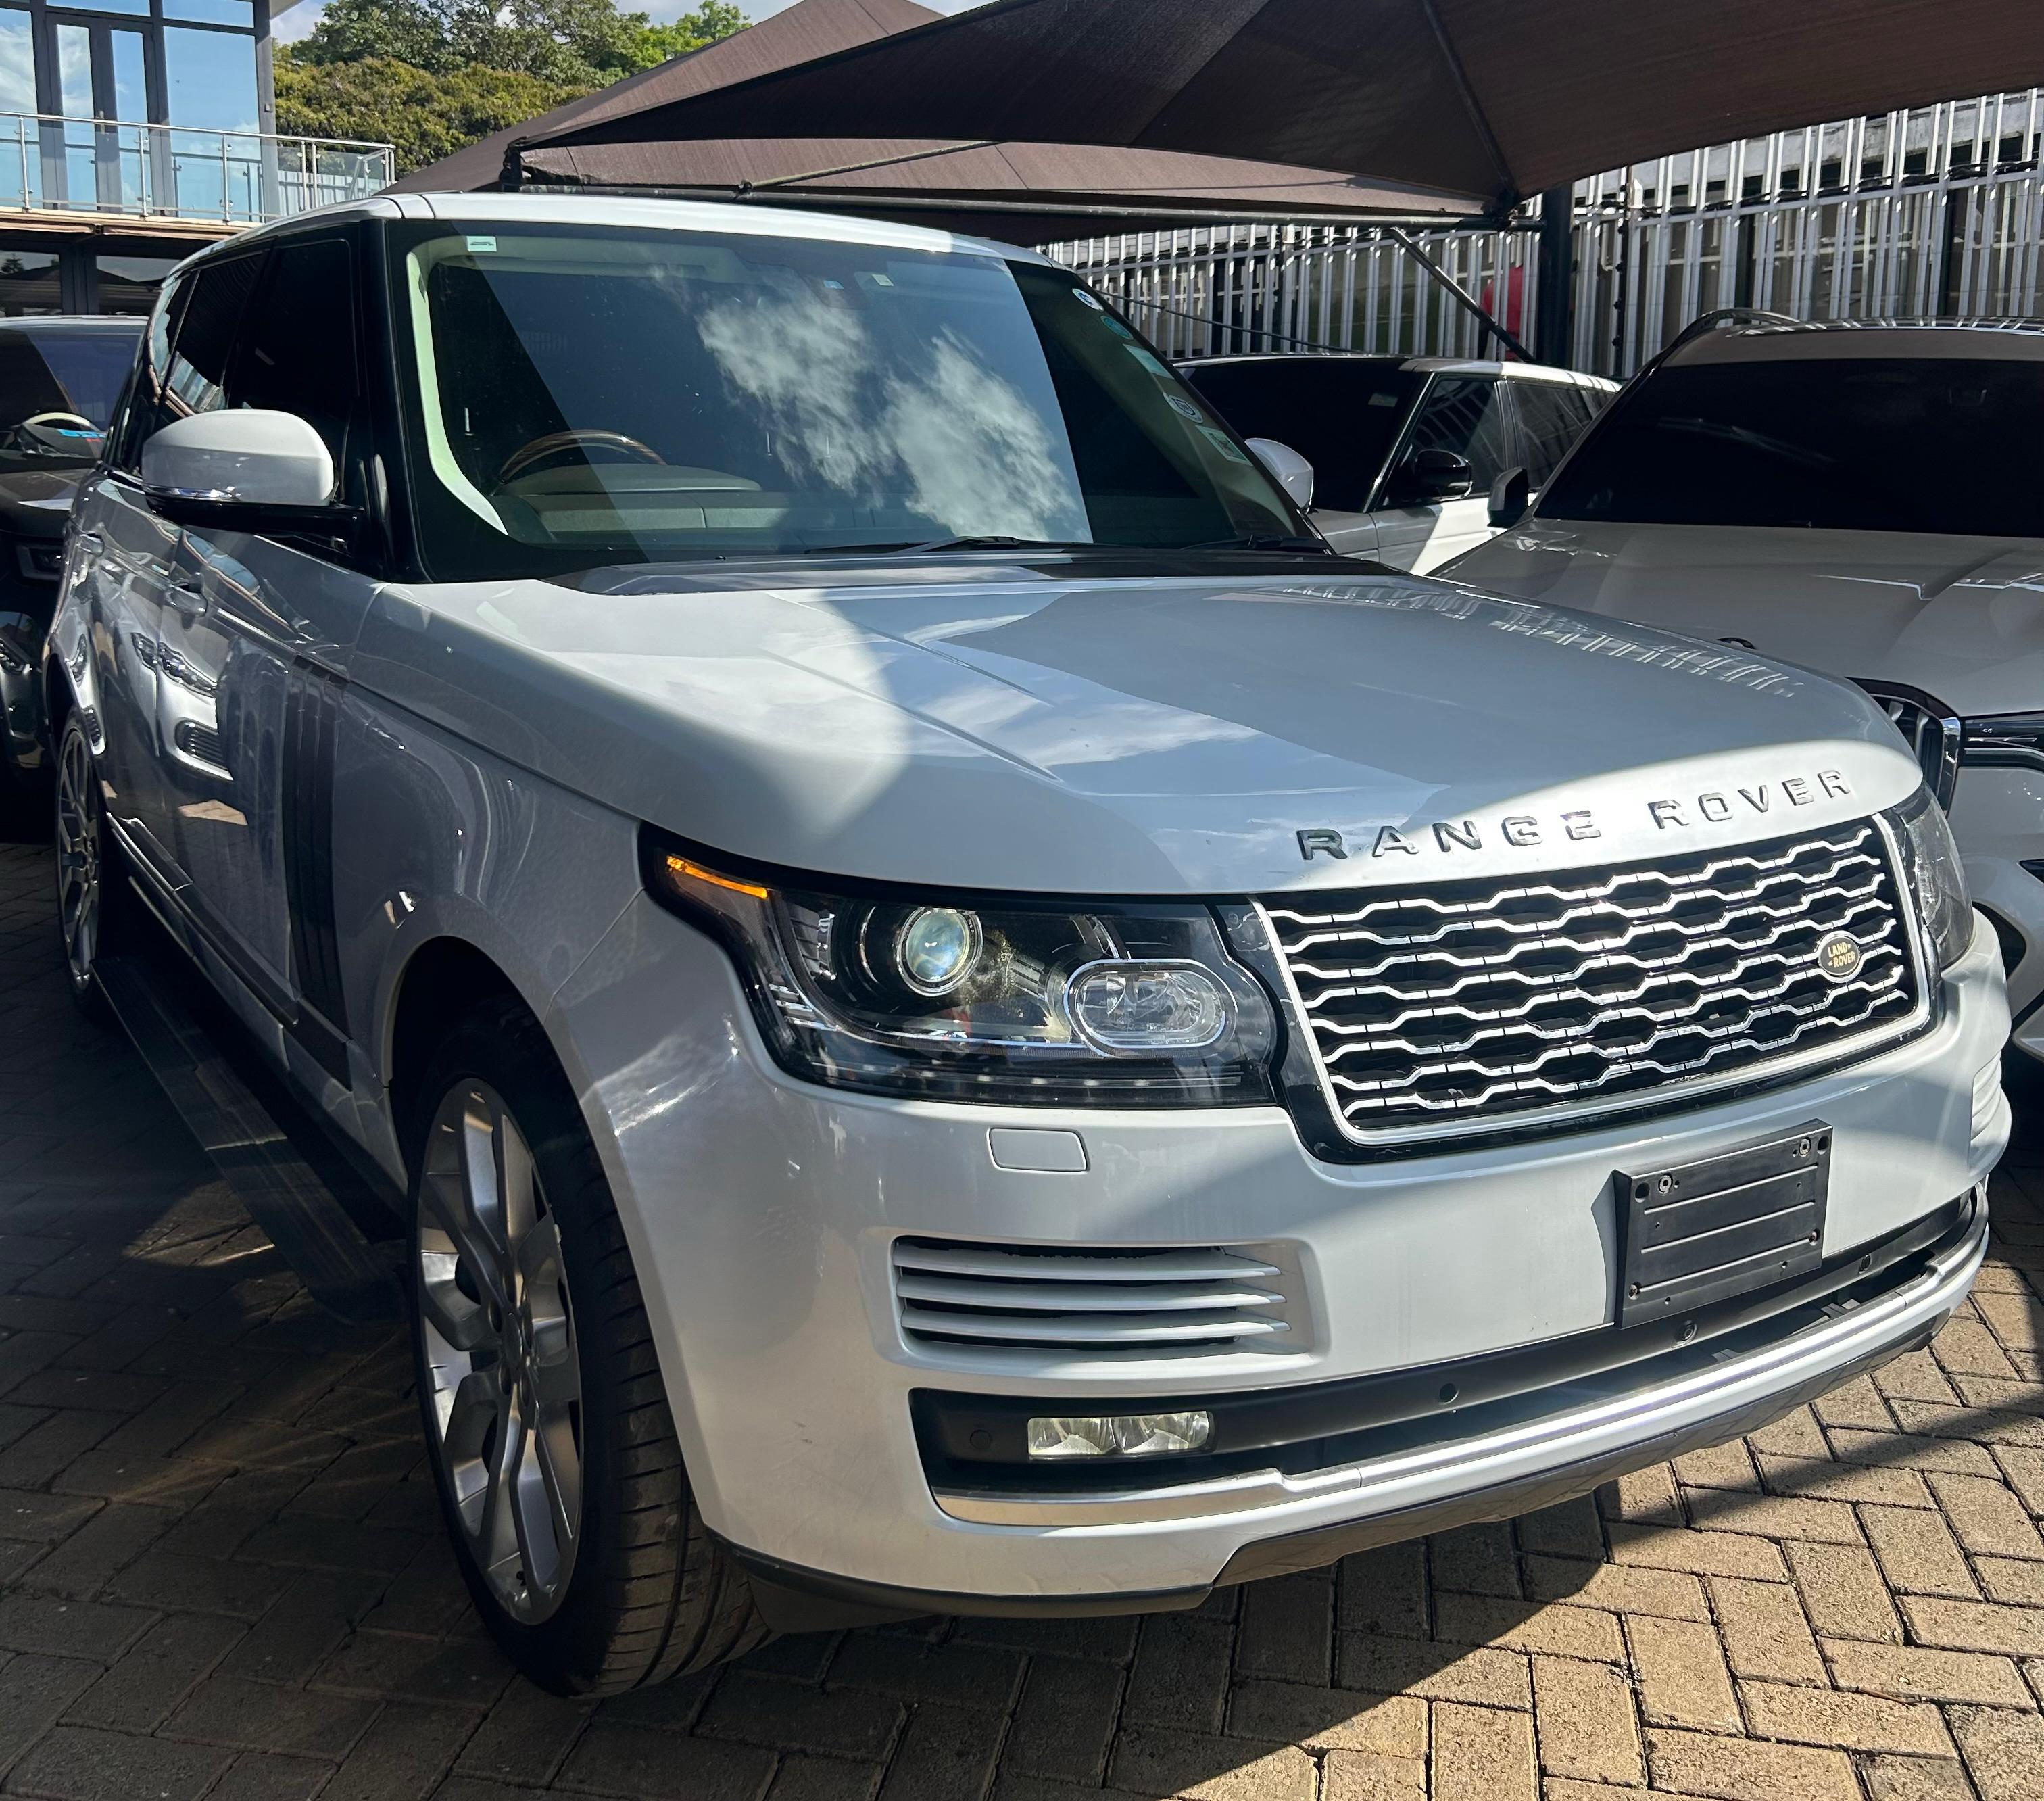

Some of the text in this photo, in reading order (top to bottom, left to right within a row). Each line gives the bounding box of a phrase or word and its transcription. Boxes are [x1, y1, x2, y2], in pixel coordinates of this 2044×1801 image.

[1296, 769, 1851, 860] RANGE ROVER
[1828, 942, 1847, 957] LAND
[1833, 951, 1855, 967] ROVER
